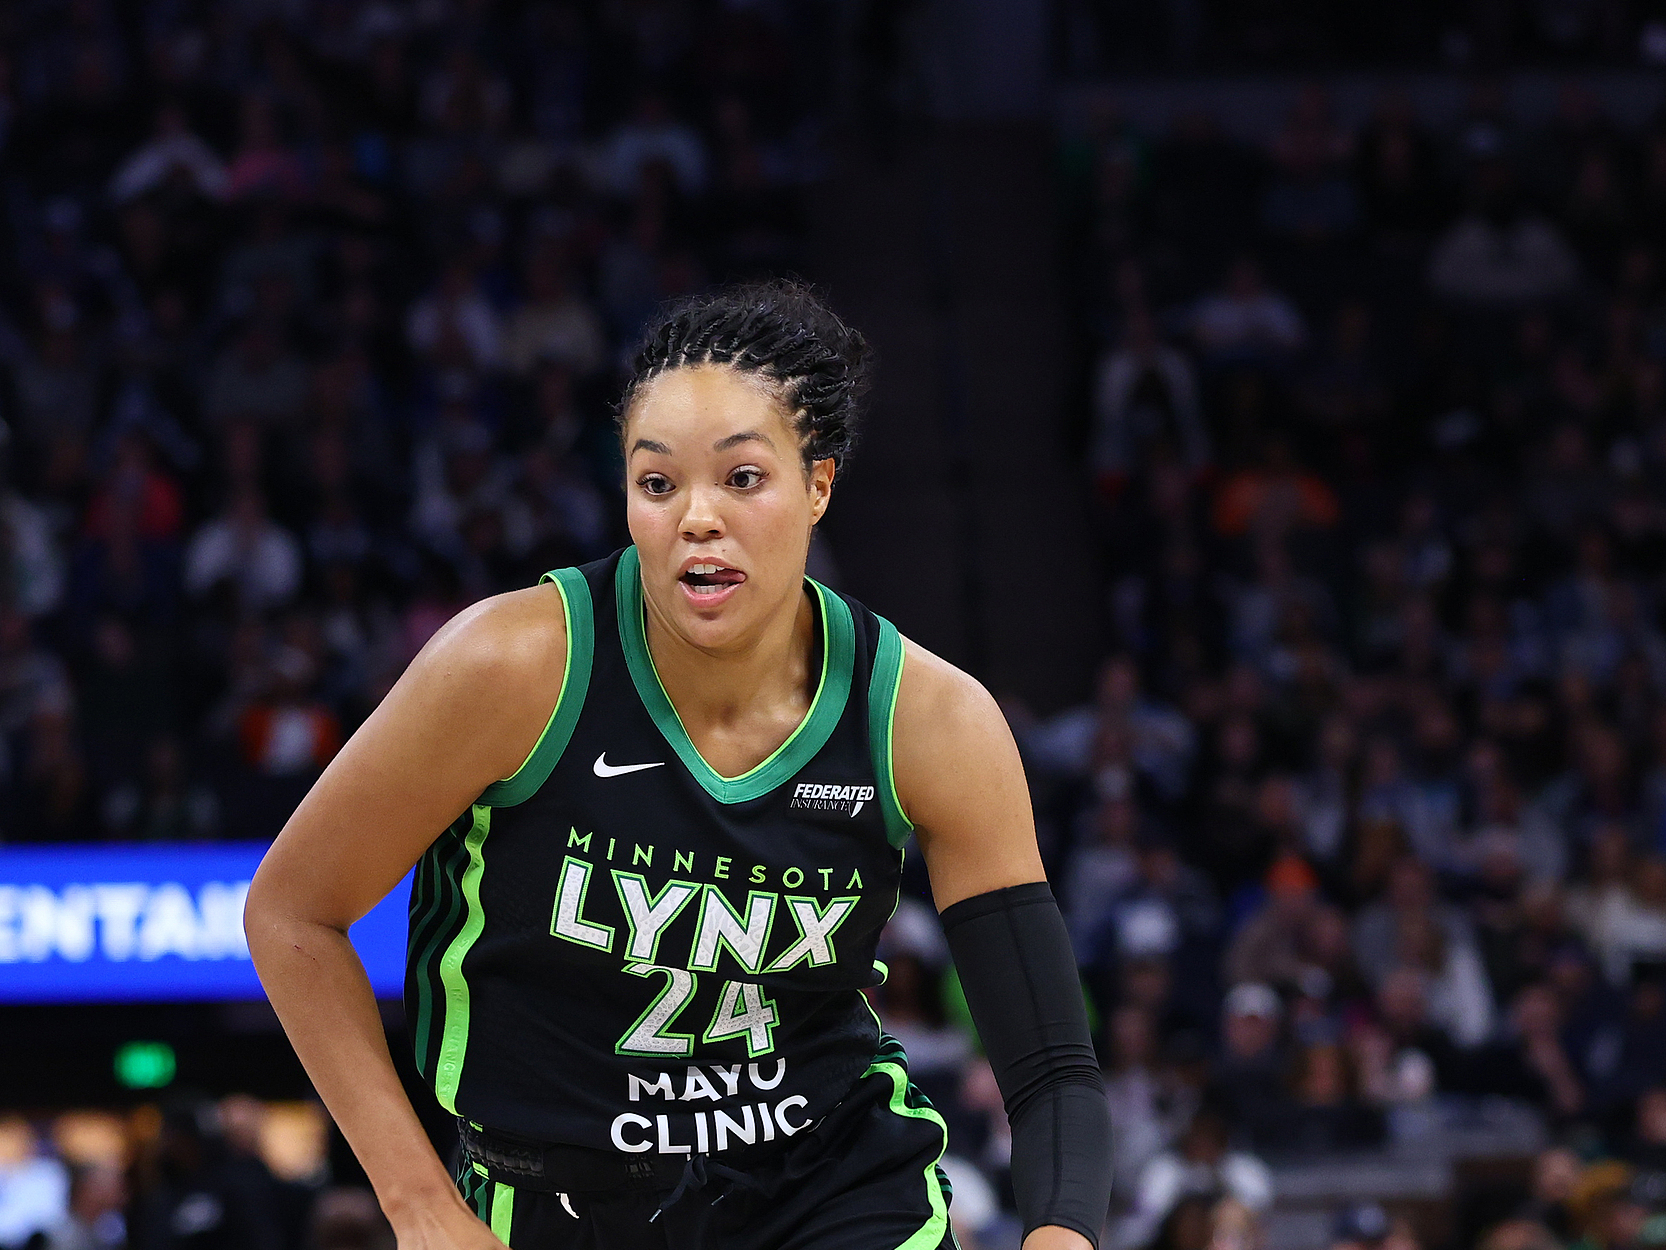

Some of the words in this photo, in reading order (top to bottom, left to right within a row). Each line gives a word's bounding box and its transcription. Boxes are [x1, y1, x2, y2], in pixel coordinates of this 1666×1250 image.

[790, 799, 849, 811] INSURANCE
[793, 783, 875, 801] FEDERATED
[567, 826, 863, 891] MINNESOTA
[549, 854, 861, 975] LYNX
[615, 963, 780, 1059] 24
[627, 1057, 786, 1102] MAYO
[610, 1095, 813, 1155] CLINIC
